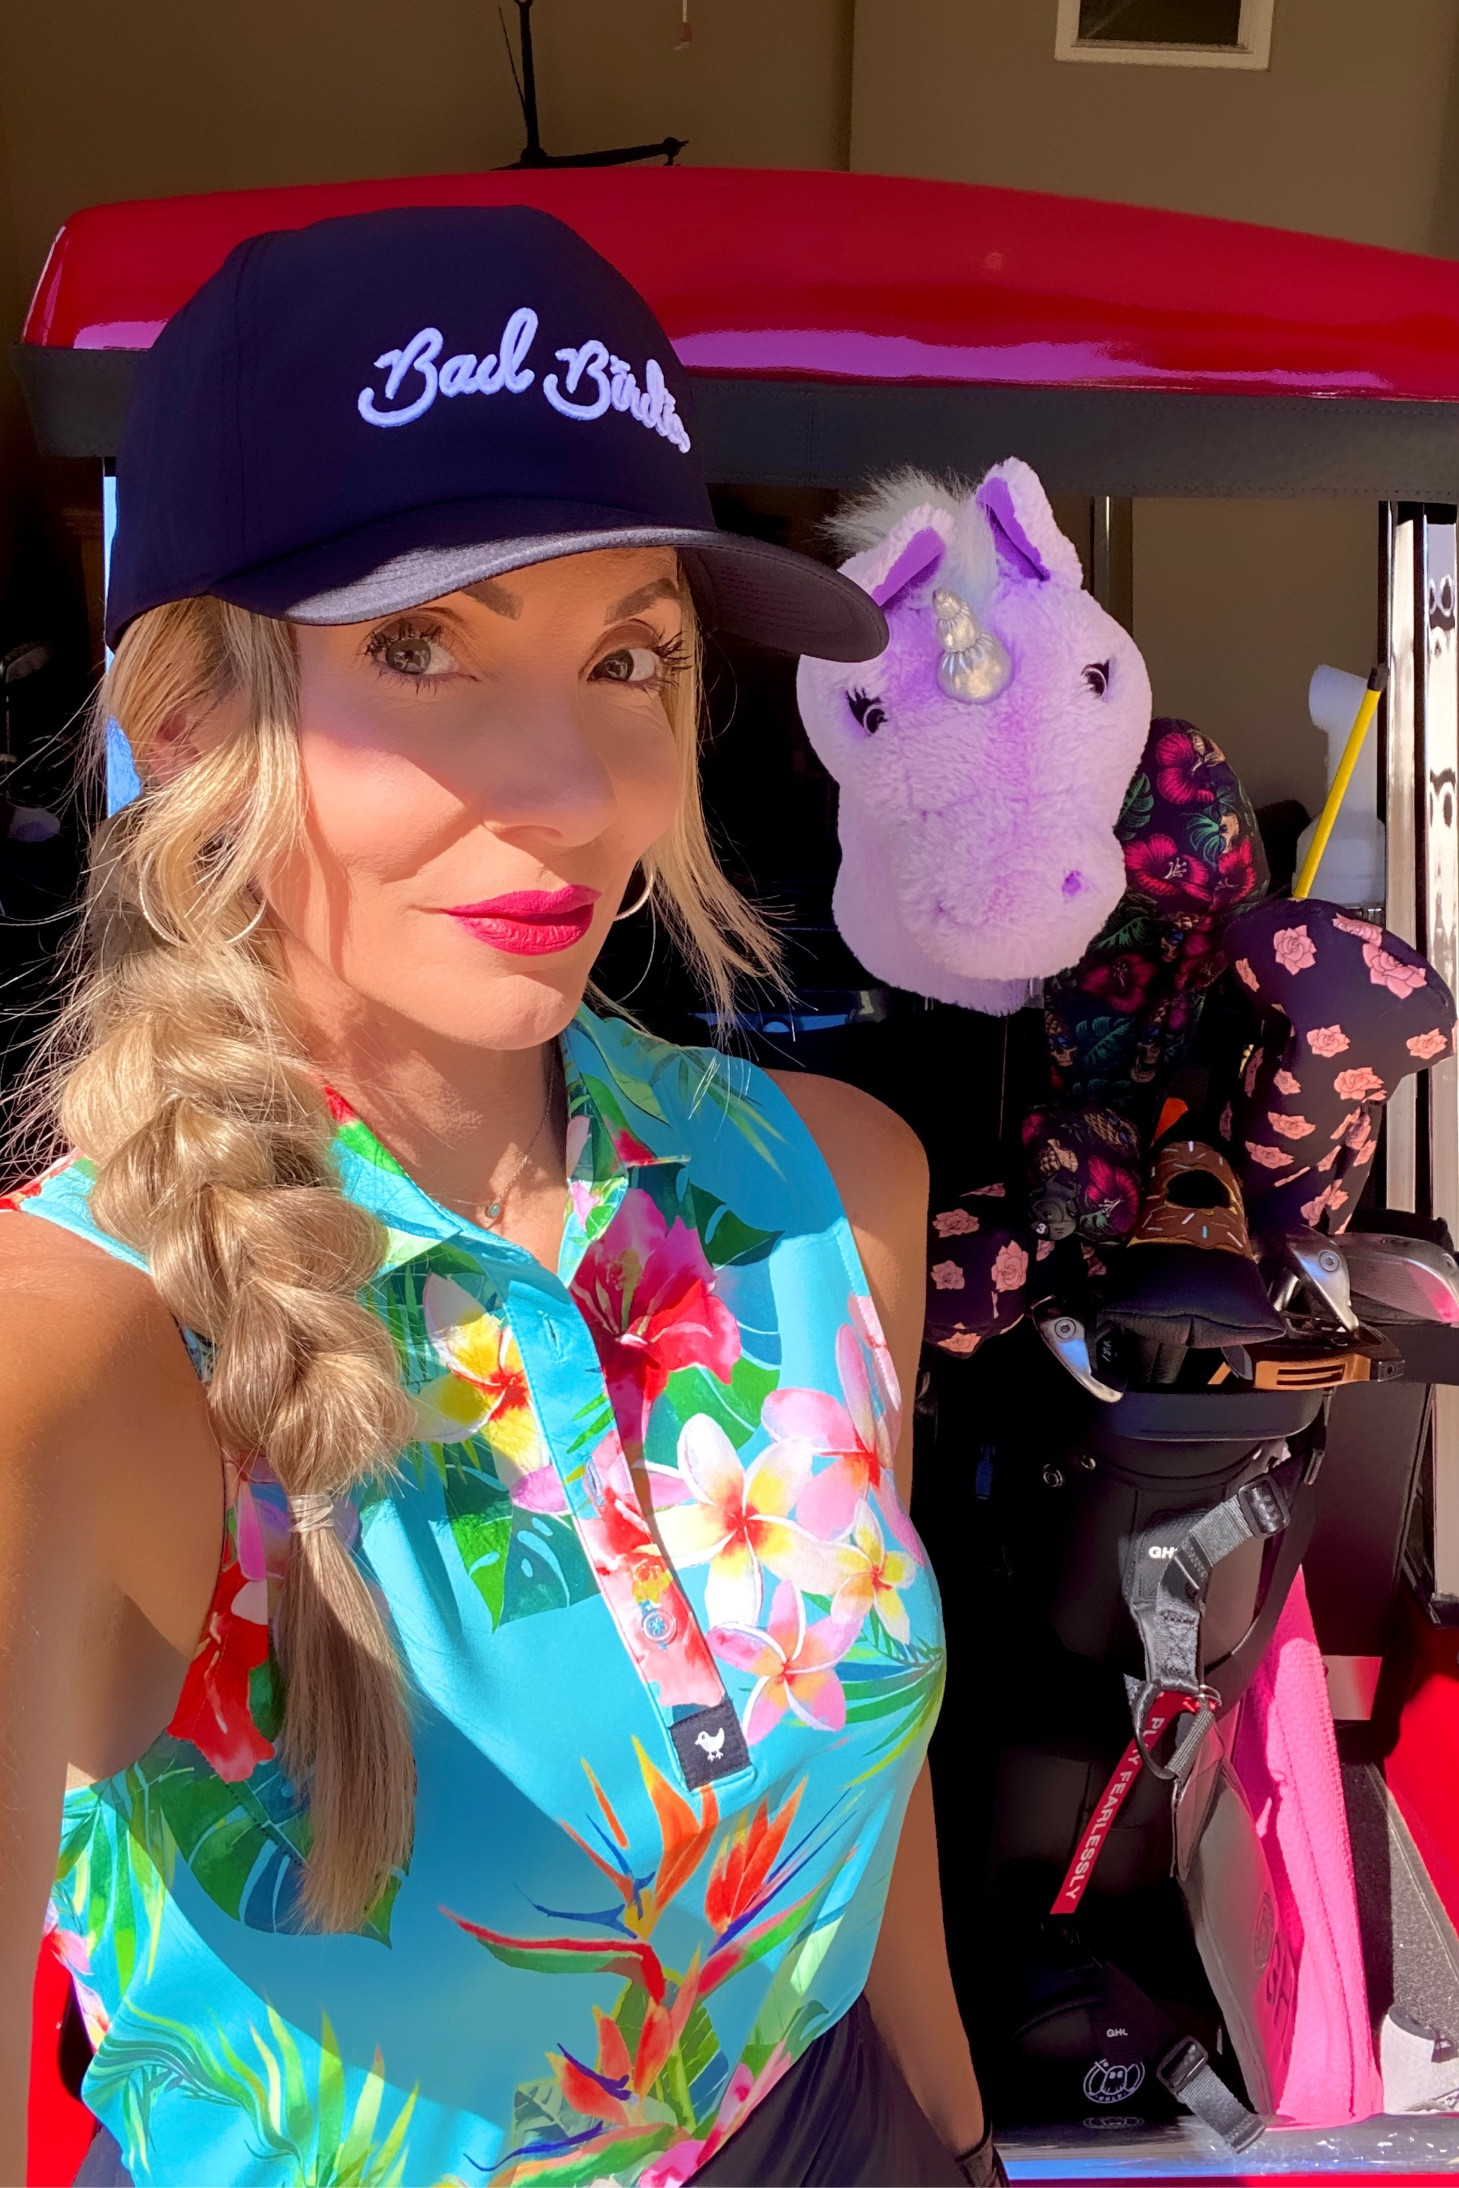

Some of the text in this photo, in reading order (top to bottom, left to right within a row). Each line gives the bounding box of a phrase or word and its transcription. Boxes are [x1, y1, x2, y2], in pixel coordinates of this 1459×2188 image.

[358, 307, 538, 428] Bad
[1148, 1545, 1178, 1559] GH
[1064, 1716, 1166, 1901] PLY FEARLESSLY
